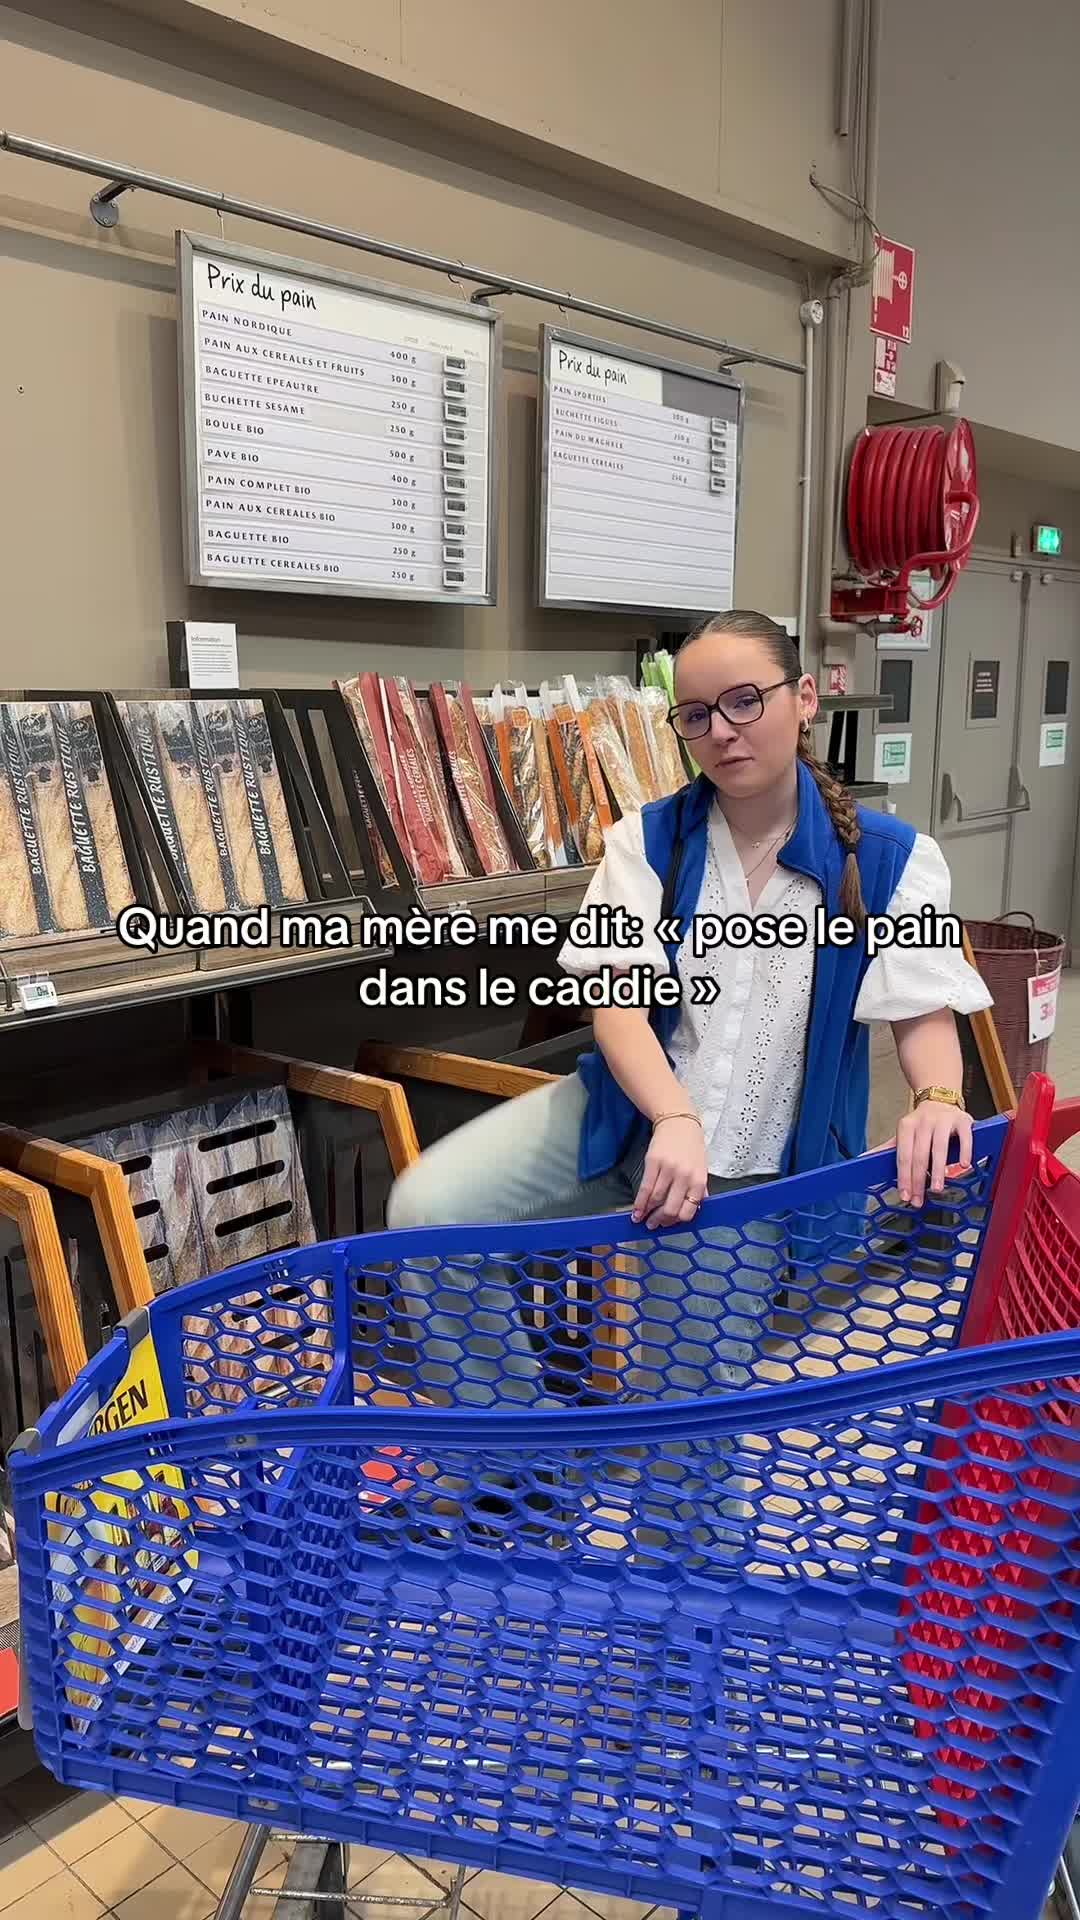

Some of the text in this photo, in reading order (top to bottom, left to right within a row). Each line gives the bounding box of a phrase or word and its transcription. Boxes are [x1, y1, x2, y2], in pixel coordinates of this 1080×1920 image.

[207, 262, 317, 312] Prix du pain
[202, 309, 293, 337] PAIN NORDIQUE
[204, 337, 366, 377] PAIN AUX CEREALES ET FRUITS
[559, 349, 628, 386] Prix du pain
[205, 365, 320, 394] BAGUETTE EPEAUTRE
[553, 385, 571, 395] PAIN
[204, 392, 305, 415] BUCHETTE SESAME
[391, 400, 407, 410] 250
[555, 407, 592, 421] BUCHETTE
[205, 418, 265, 435] BOULE BIO
[390, 424, 407, 434] 250
[555, 429, 573, 438] PAIN
[575, 433, 586, 441] DU
[207, 448, 259, 463] PAVE BIO
[553, 450, 589, 464] BAGUETTE
[207, 475, 311, 495] PAIN COMPLET BIO
[206, 499, 336, 522] PAIN AUX CEREALES BIO
[208, 529, 289, 544] BAGUETTE BIO
[207, 553, 340, 573] BAGUETTE CEREALES BIO
[137, 725, 163, 795] RUSTIQUE
[8, 735, 42, 875] BAGUETTE RUSTIQUE
[207, 795, 229, 857] BAGUETTE
[247, 788, 272, 855] BAGUETTE
[70, 801, 97, 873] BAGUETTE
